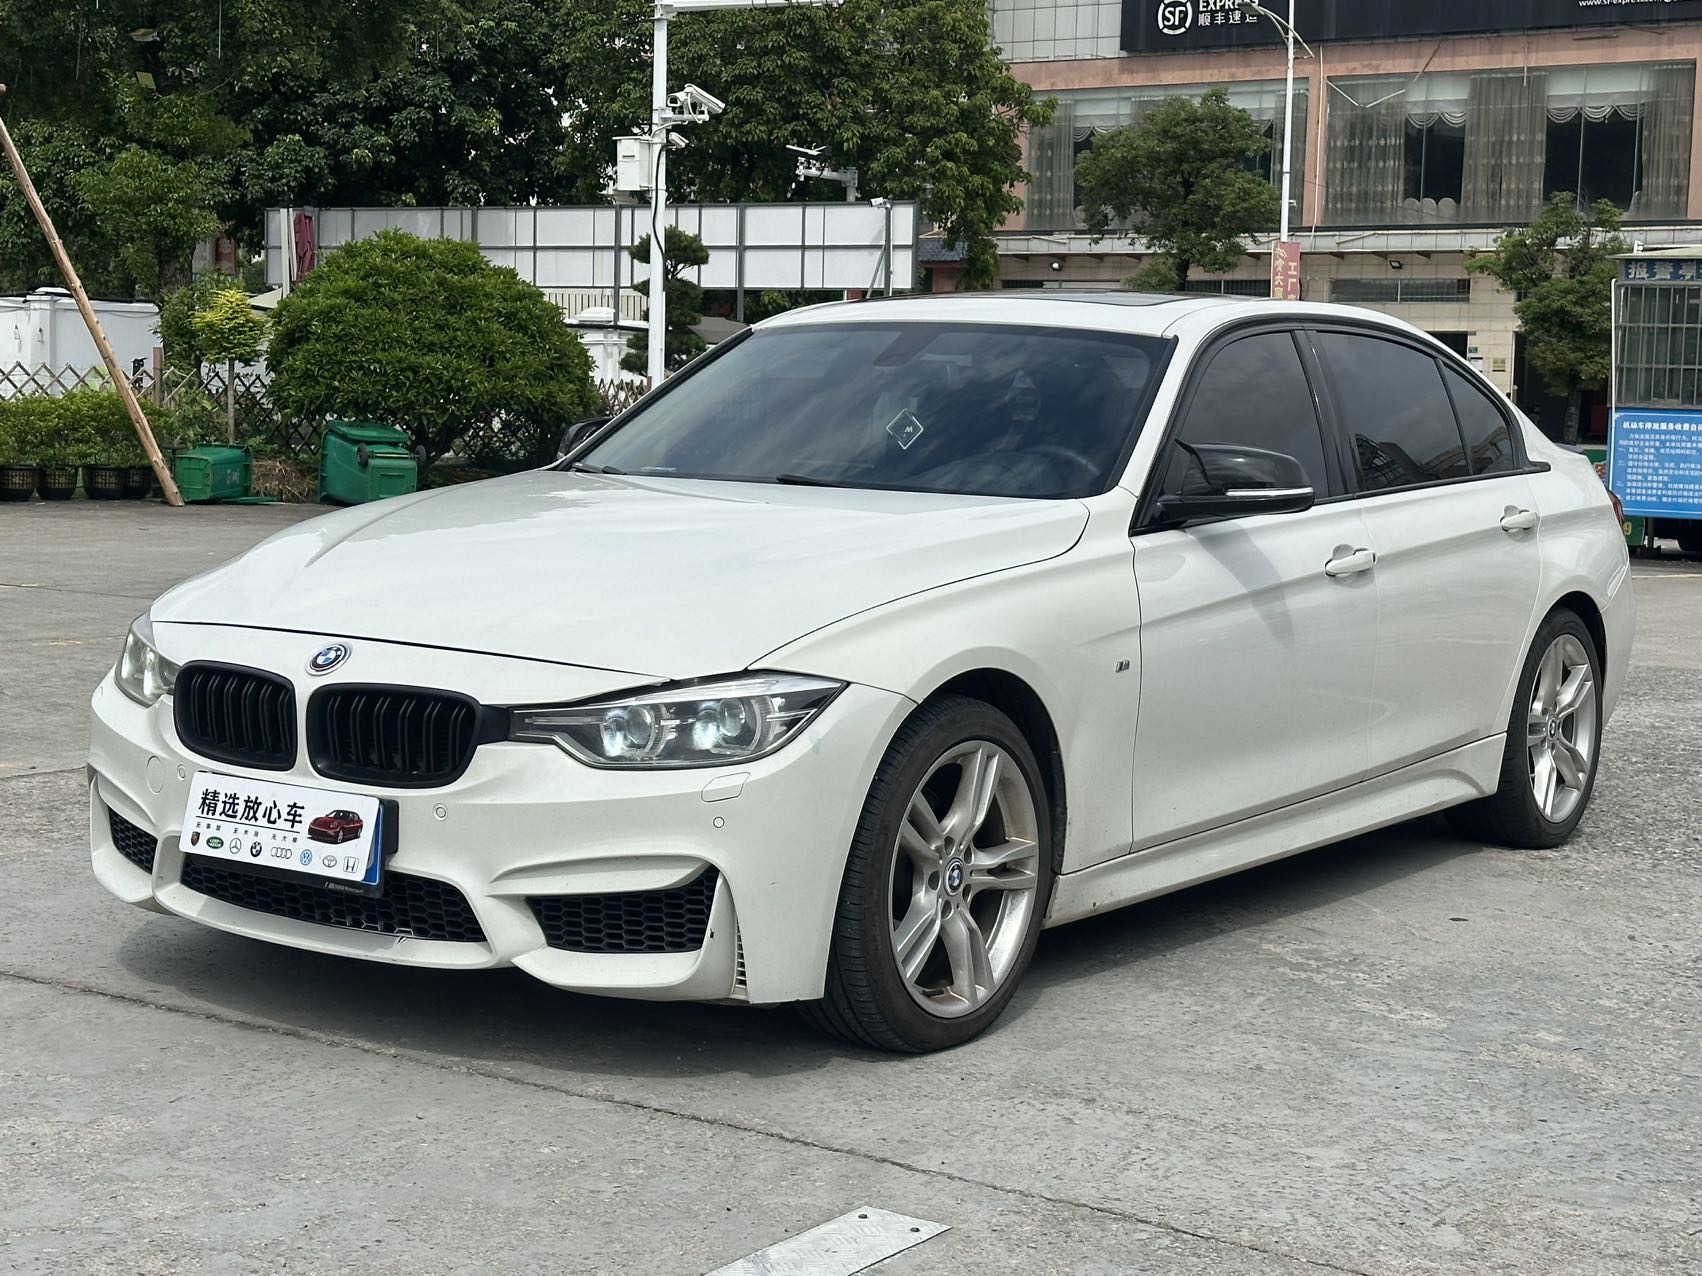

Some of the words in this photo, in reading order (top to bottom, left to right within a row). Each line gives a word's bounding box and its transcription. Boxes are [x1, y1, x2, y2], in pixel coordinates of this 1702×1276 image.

[198, 788, 305, 829] 精选放心车
